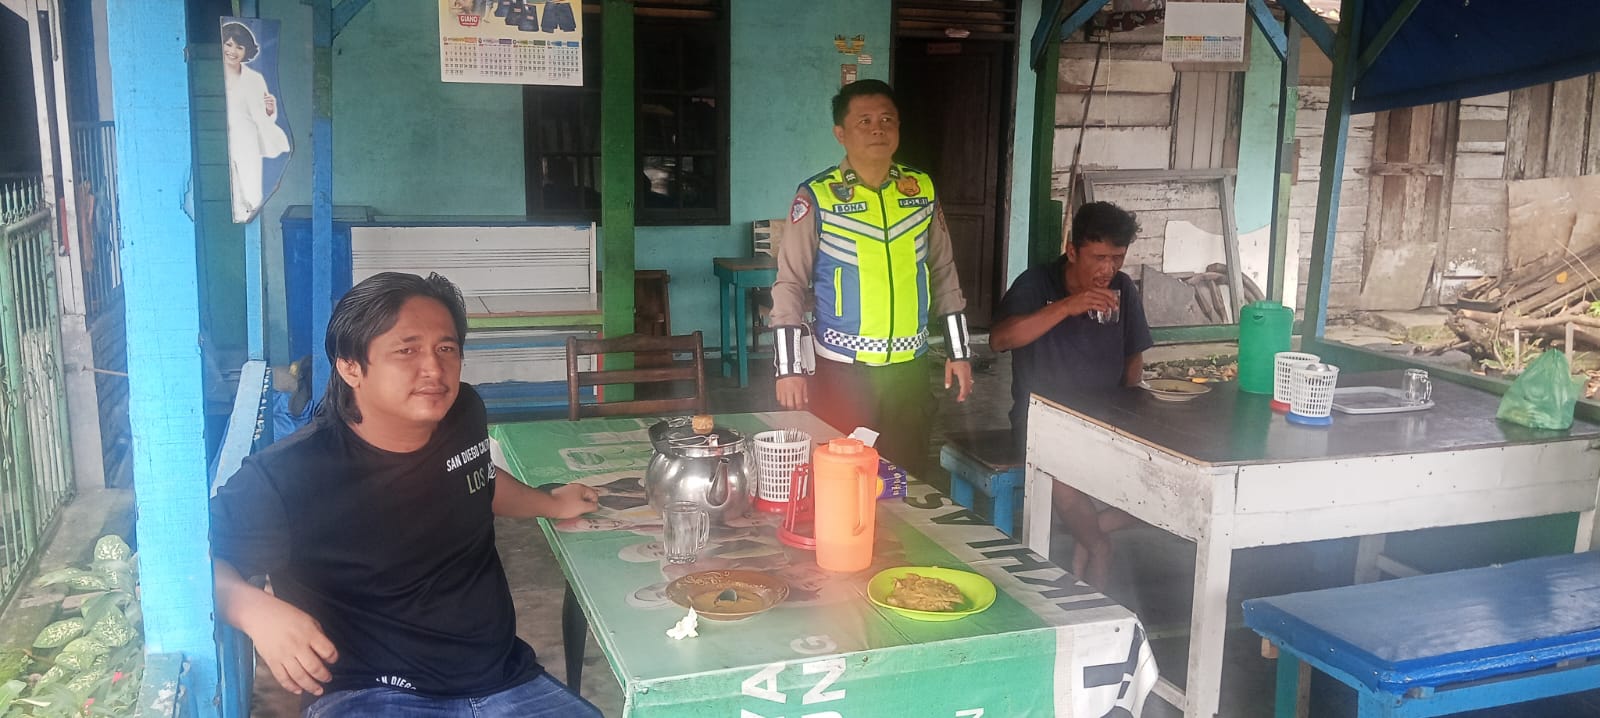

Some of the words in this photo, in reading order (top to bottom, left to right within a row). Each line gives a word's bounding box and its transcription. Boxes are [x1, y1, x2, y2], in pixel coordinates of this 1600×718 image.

[836, 203, 864, 213] BONA
[900, 198, 927, 206] POLRI
[446, 454, 462, 472] SAN
[461, 445, 480, 464] DIEGO
[466, 467, 485, 494] LOS
